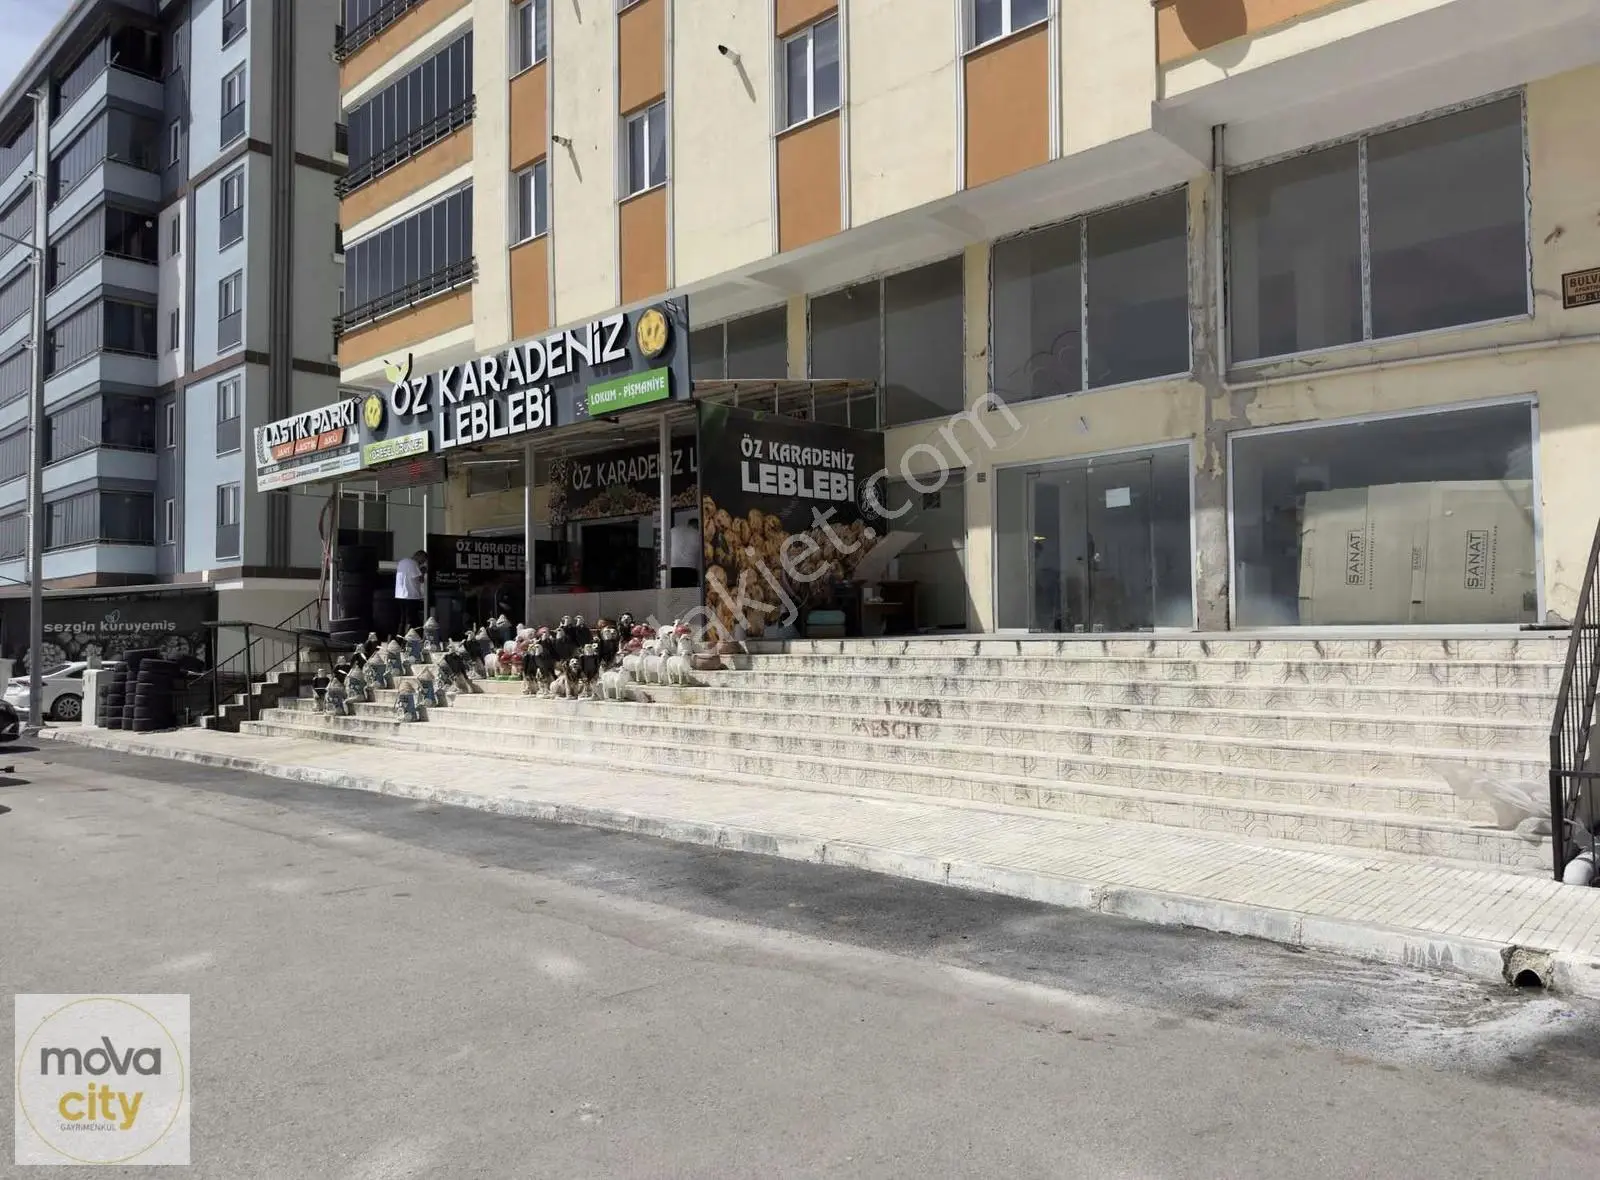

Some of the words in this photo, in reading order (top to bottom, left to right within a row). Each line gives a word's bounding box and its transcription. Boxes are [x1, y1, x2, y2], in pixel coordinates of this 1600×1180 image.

[438, 313, 626, 407] KARADENİZ
[590, 389, 617, 405] LOKUM
[623, 376, 665, 399] PİŞMANİYE
[310, 401, 355, 437] PARKI
[438, 385, 552, 450] LEBLEBİ
[572, 461, 592, 491] ÖZ
[596, 449, 683, 486] KARADEZ
[741, 433, 763, 459] ÖZ
[769, 441, 855, 471] KARADENİZ
[741, 461, 855, 502] LEBLEBİ
[474, 541, 525, 554] KARADEN
[1348, 532, 1361, 585] SANAT
[1467, 532, 1482, 588] SANAT
[43, 621, 95, 634] sezgin
